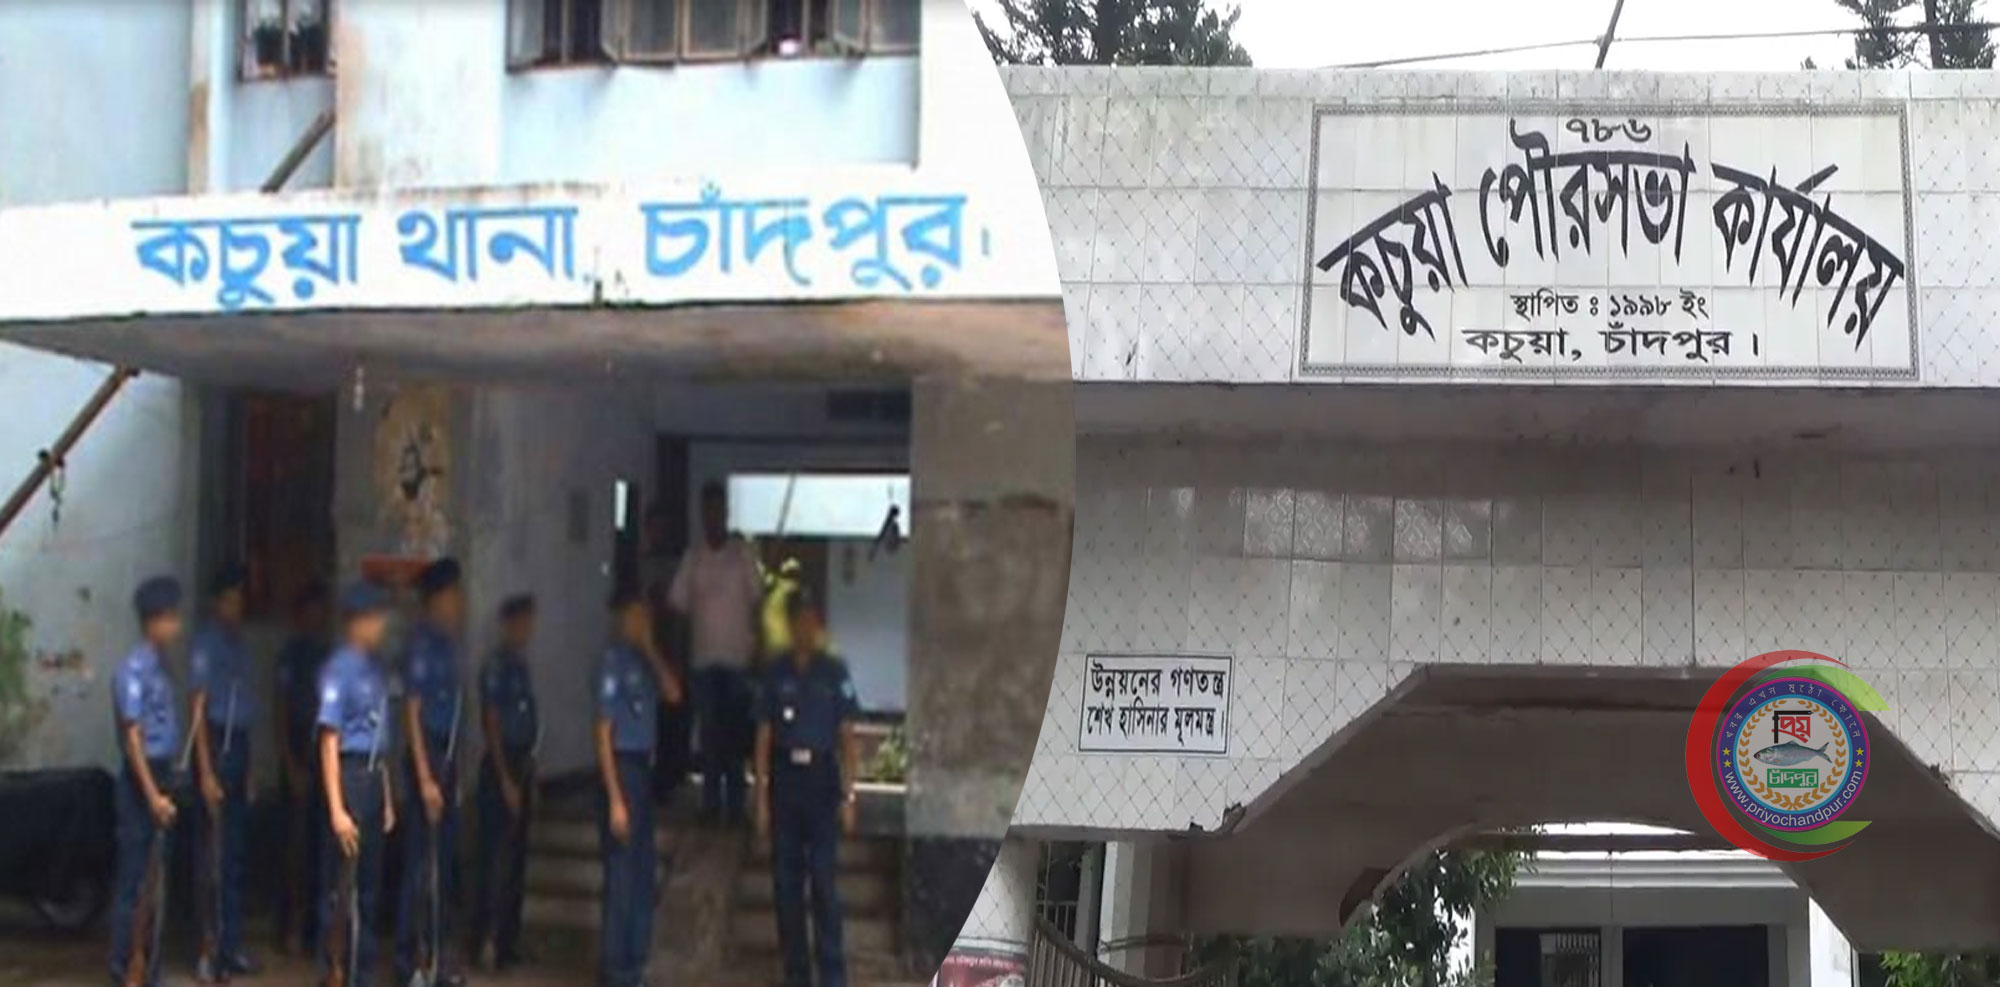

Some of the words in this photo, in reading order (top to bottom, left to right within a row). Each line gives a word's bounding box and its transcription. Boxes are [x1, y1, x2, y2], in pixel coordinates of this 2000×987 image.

[1565, 118, 1652, 143] ৭৮৬
[1316, 171, 1469, 342] কচুয়া
[1479, 117, 1697, 268] পৌরসভা
[1710, 163, 1905, 352] কার্যালয়
[131, 213, 361, 310] কচুয়া
[1510, 288, 1579, 322] স্থাপিত
[1609, 294, 1672, 317] ১৯৯৮
[1679, 288, 1710, 320] ইং
[1462, 327, 1582, 363] কচুয়া,
[1090, 659, 1163, 701] উন্নয়নের
[1170, 665, 1226, 700] গণতন্ত্র
[1087, 702, 1115, 736] শেখ
[1119, 696, 1170, 740] হাসিনার
